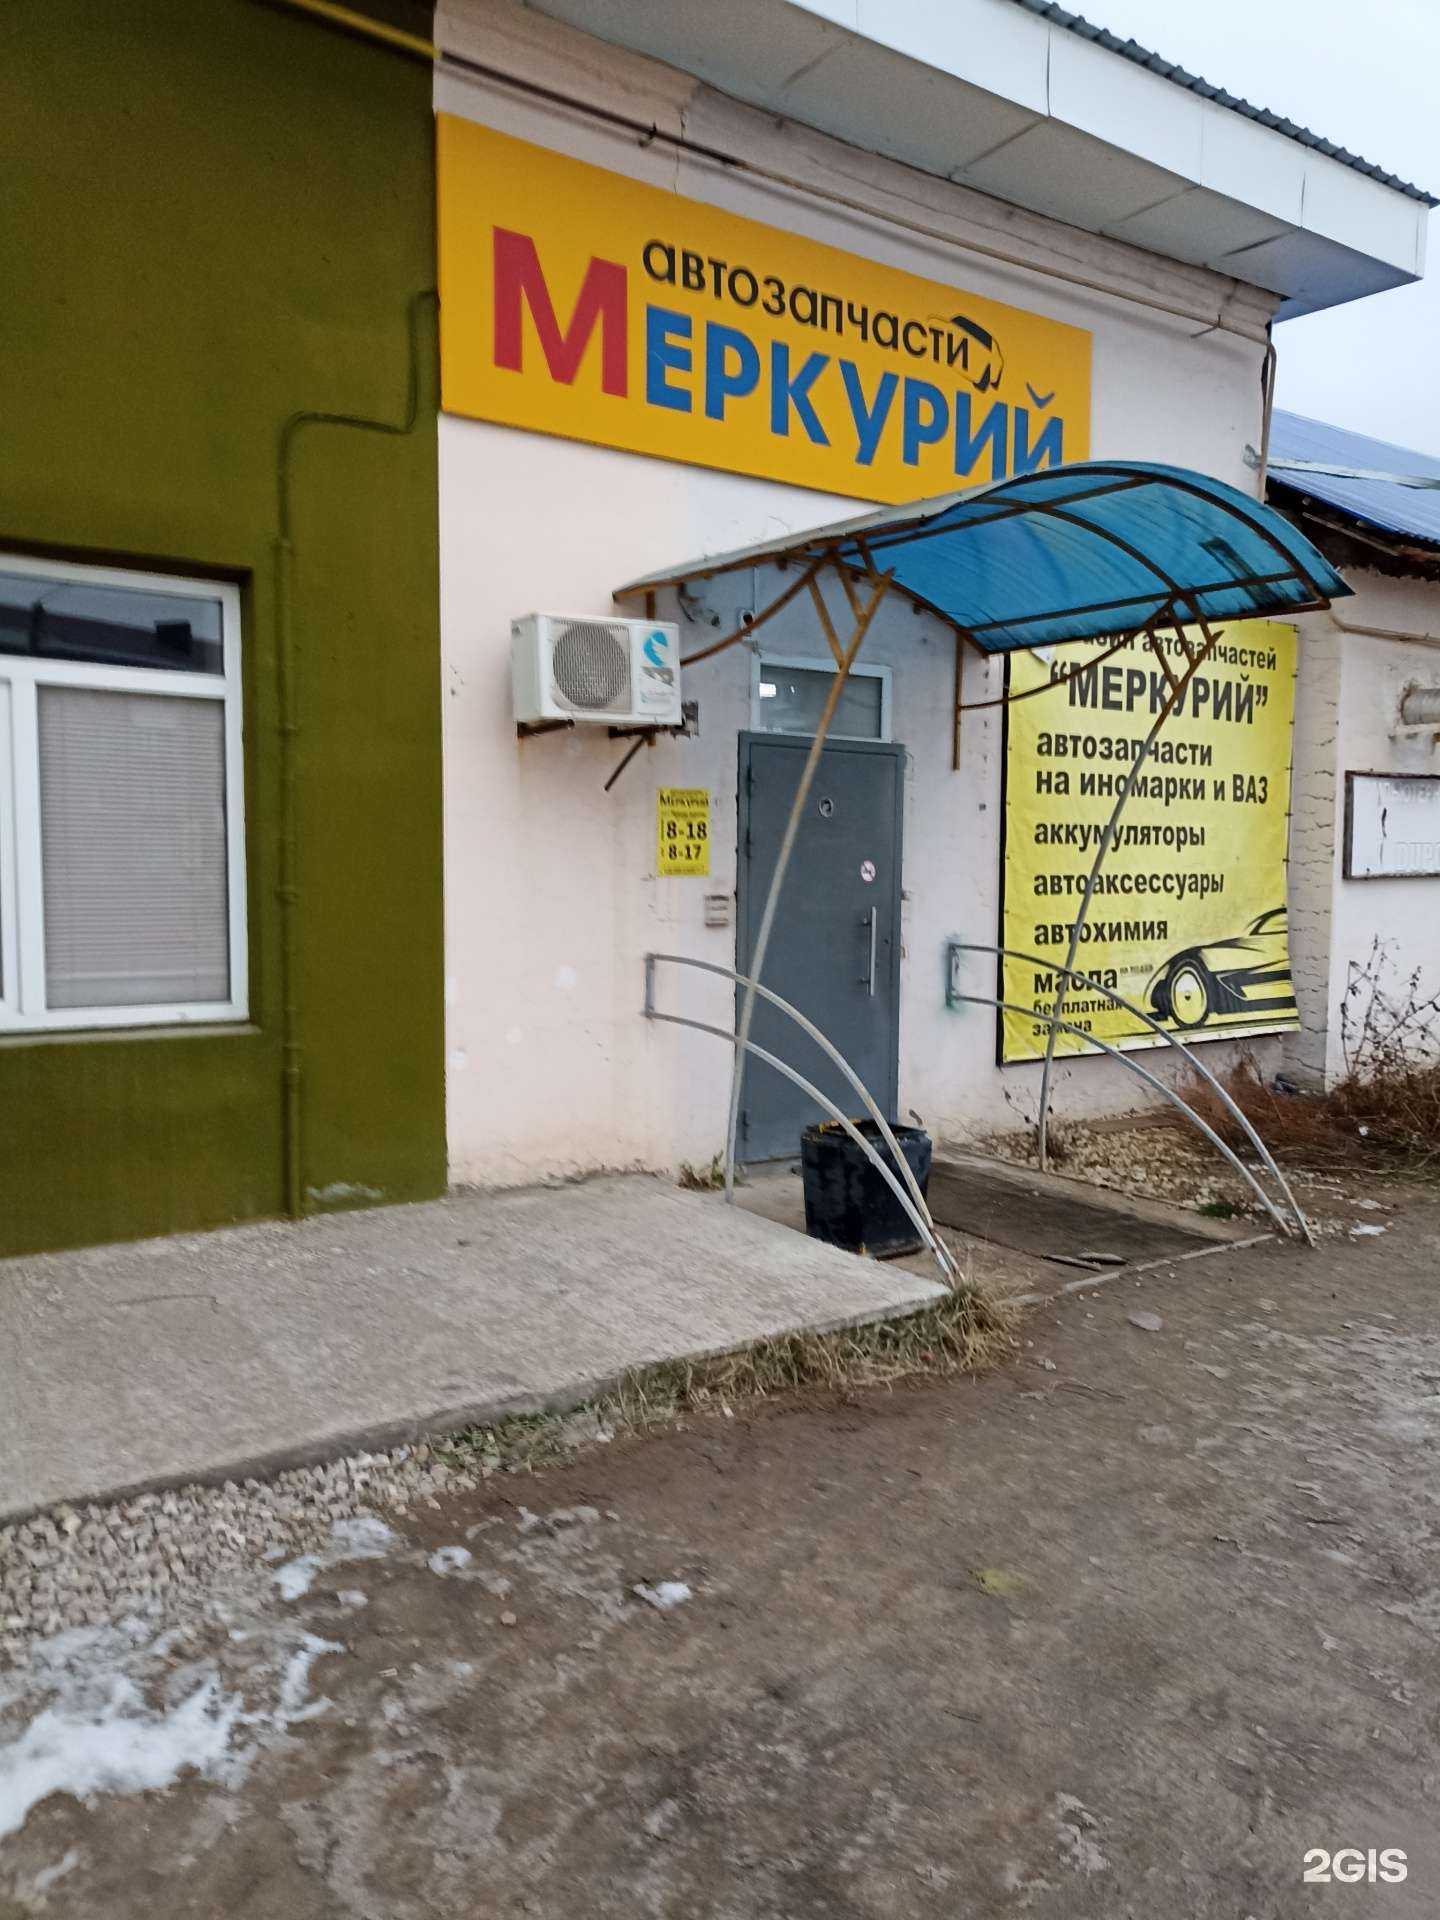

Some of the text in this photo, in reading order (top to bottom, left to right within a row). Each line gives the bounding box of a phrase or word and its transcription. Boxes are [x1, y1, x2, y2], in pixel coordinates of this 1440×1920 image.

[642, 238, 969, 370] автозапчасти
[492, 225, 1064, 482] МЕРКУРИЙ
[1036, 732, 1213, 766] автозапчасти
[1036, 770, 1268, 806] на иномарки и ВАЗ
[1034, 822, 1206, 852] аккумуляторы
[1033, 873, 1225, 900] автоаксессуары
[1034, 920, 1168, 945] автохимия
[1034, 968, 1118, 994] масла
